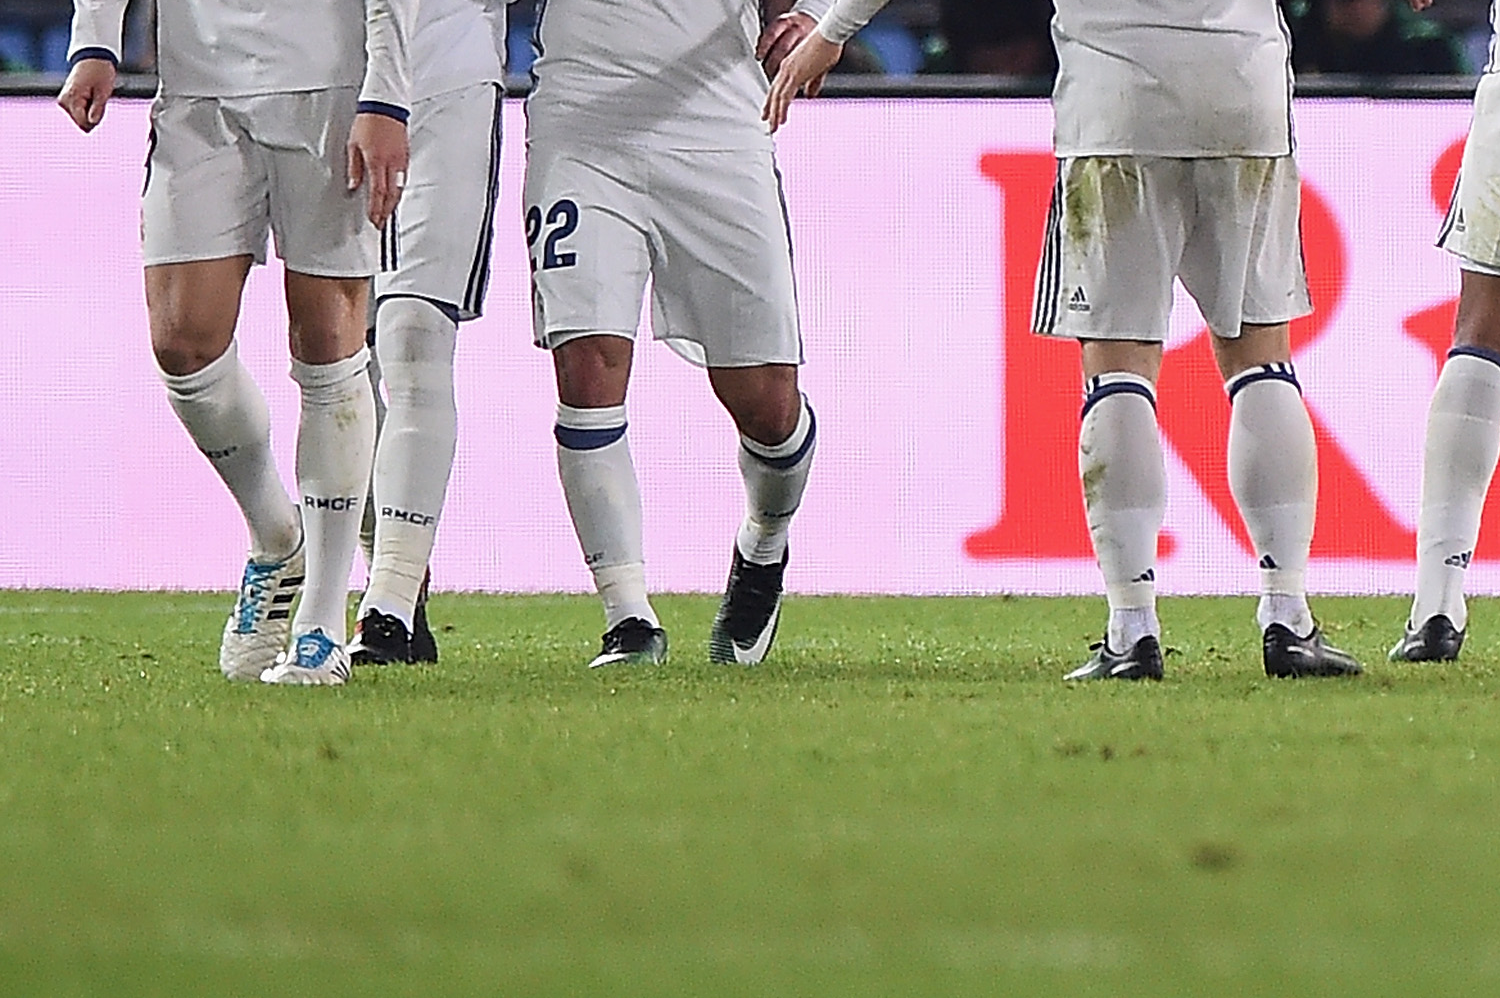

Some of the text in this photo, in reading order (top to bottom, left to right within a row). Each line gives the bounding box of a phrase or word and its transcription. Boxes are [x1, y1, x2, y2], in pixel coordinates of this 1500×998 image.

[525, 198, 578, 270] 22
[304, 495, 358, 511] RMCF
[381, 507, 435, 527] RMCF
